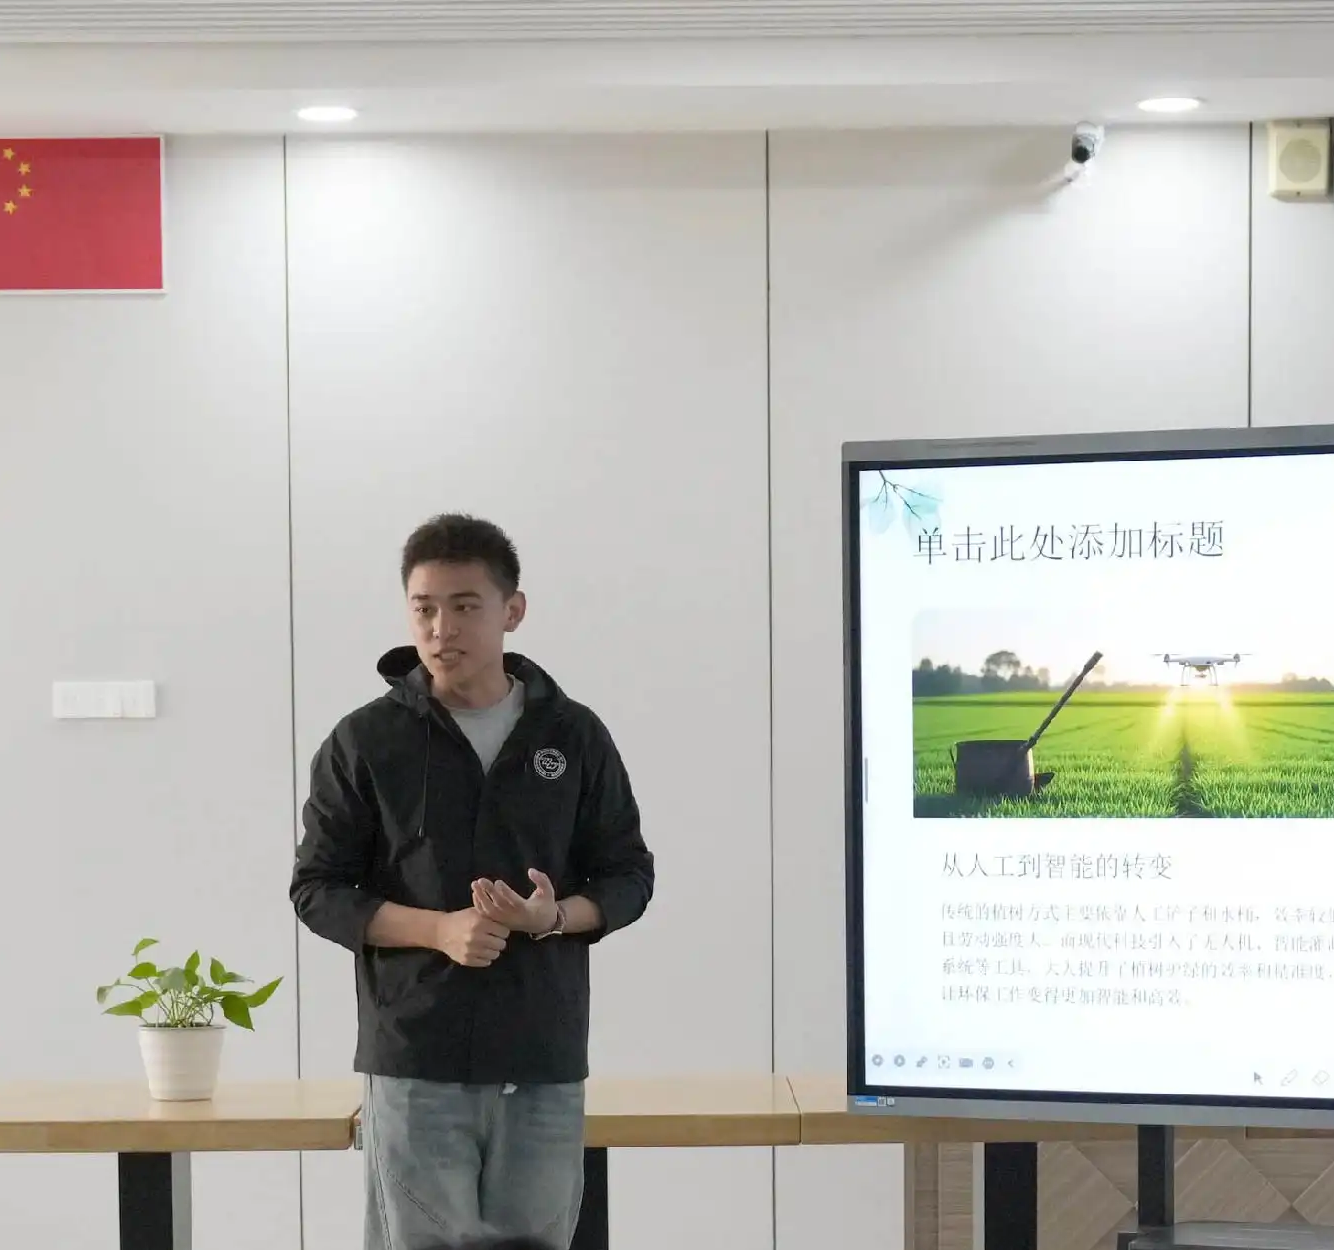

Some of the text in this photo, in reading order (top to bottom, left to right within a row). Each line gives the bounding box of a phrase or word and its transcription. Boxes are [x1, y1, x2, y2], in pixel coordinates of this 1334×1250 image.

[913, 519, 1225, 566] 单击此处添加标题
[942, 851, 1173, 880] 从人工到智能的转变
